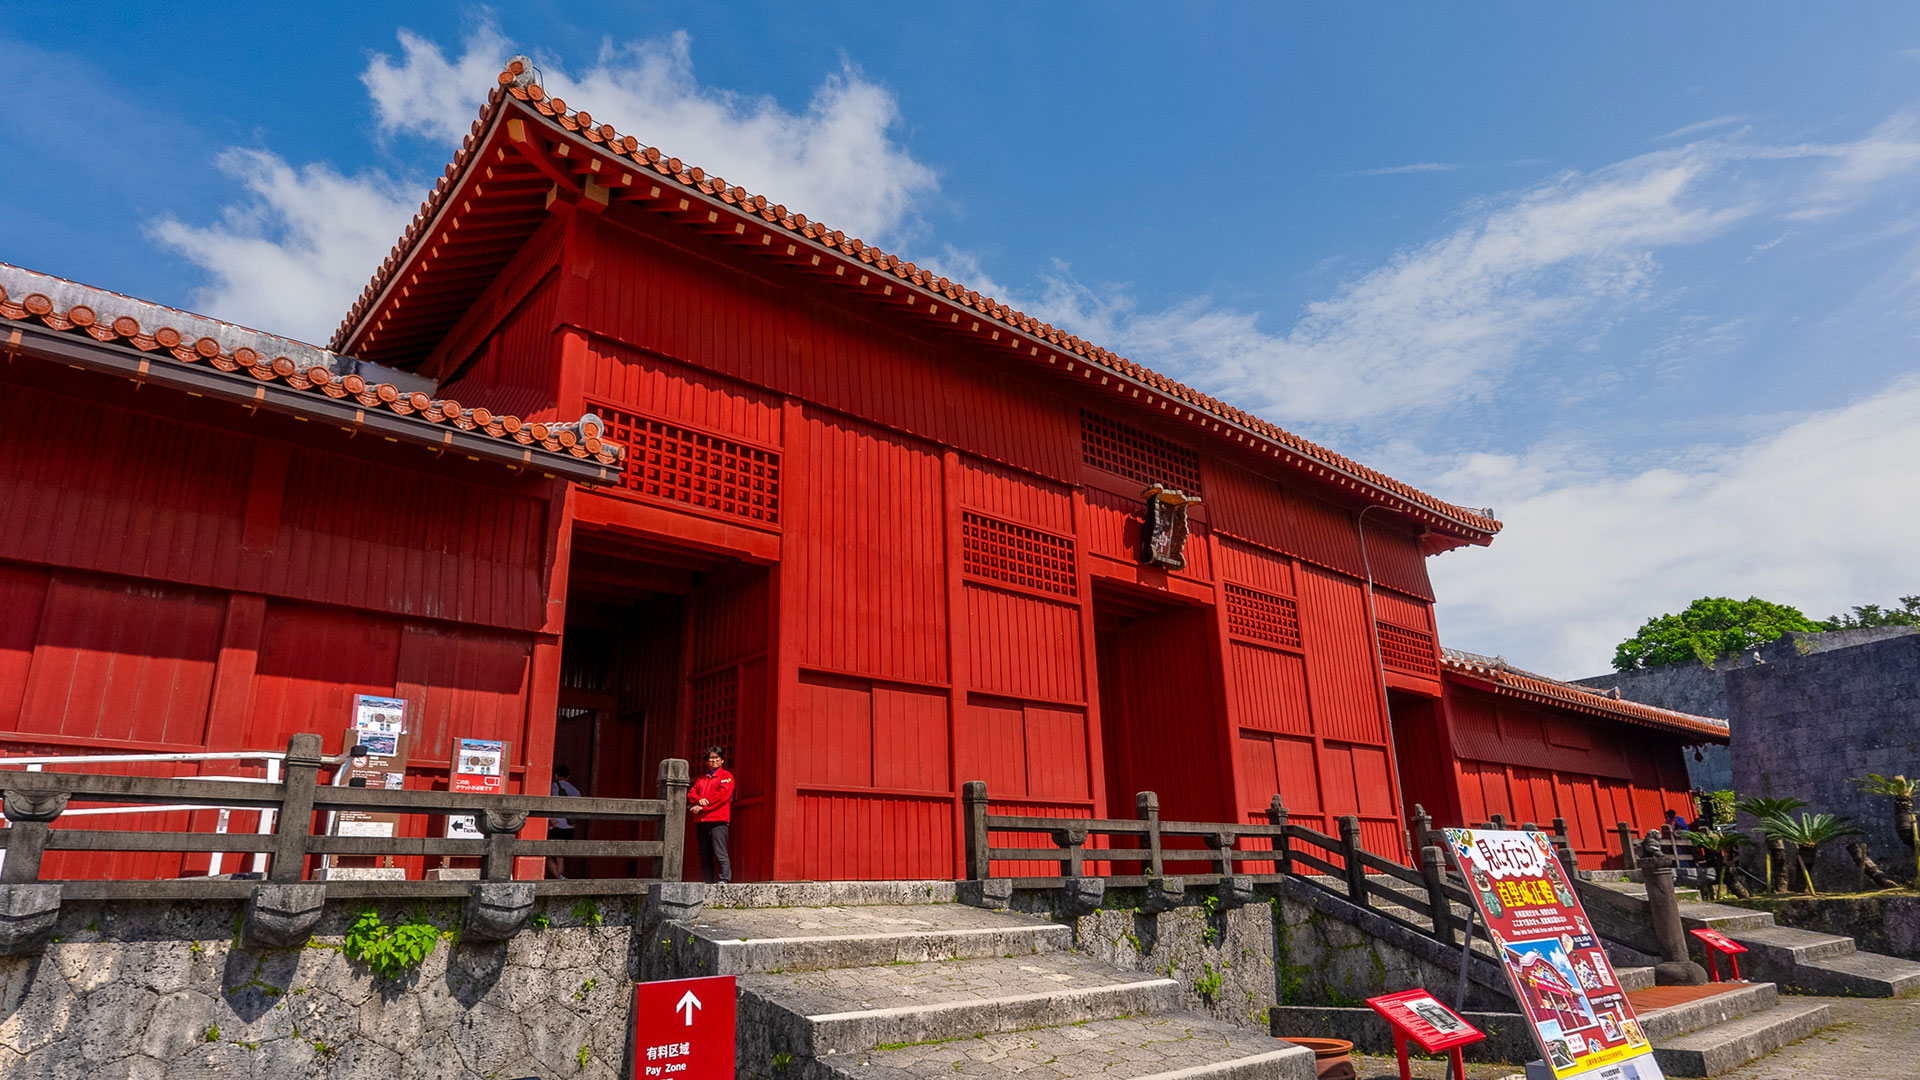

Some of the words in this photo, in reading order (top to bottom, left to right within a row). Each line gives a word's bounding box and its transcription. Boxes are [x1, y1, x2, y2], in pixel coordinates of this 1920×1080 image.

[1495, 879, 1558, 908] 首里城正殿
[646, 1042, 690, 1060] 有料区域
[645, 1066, 662, 1077] Pay
[665, 1062, 687, 1073] Zone
